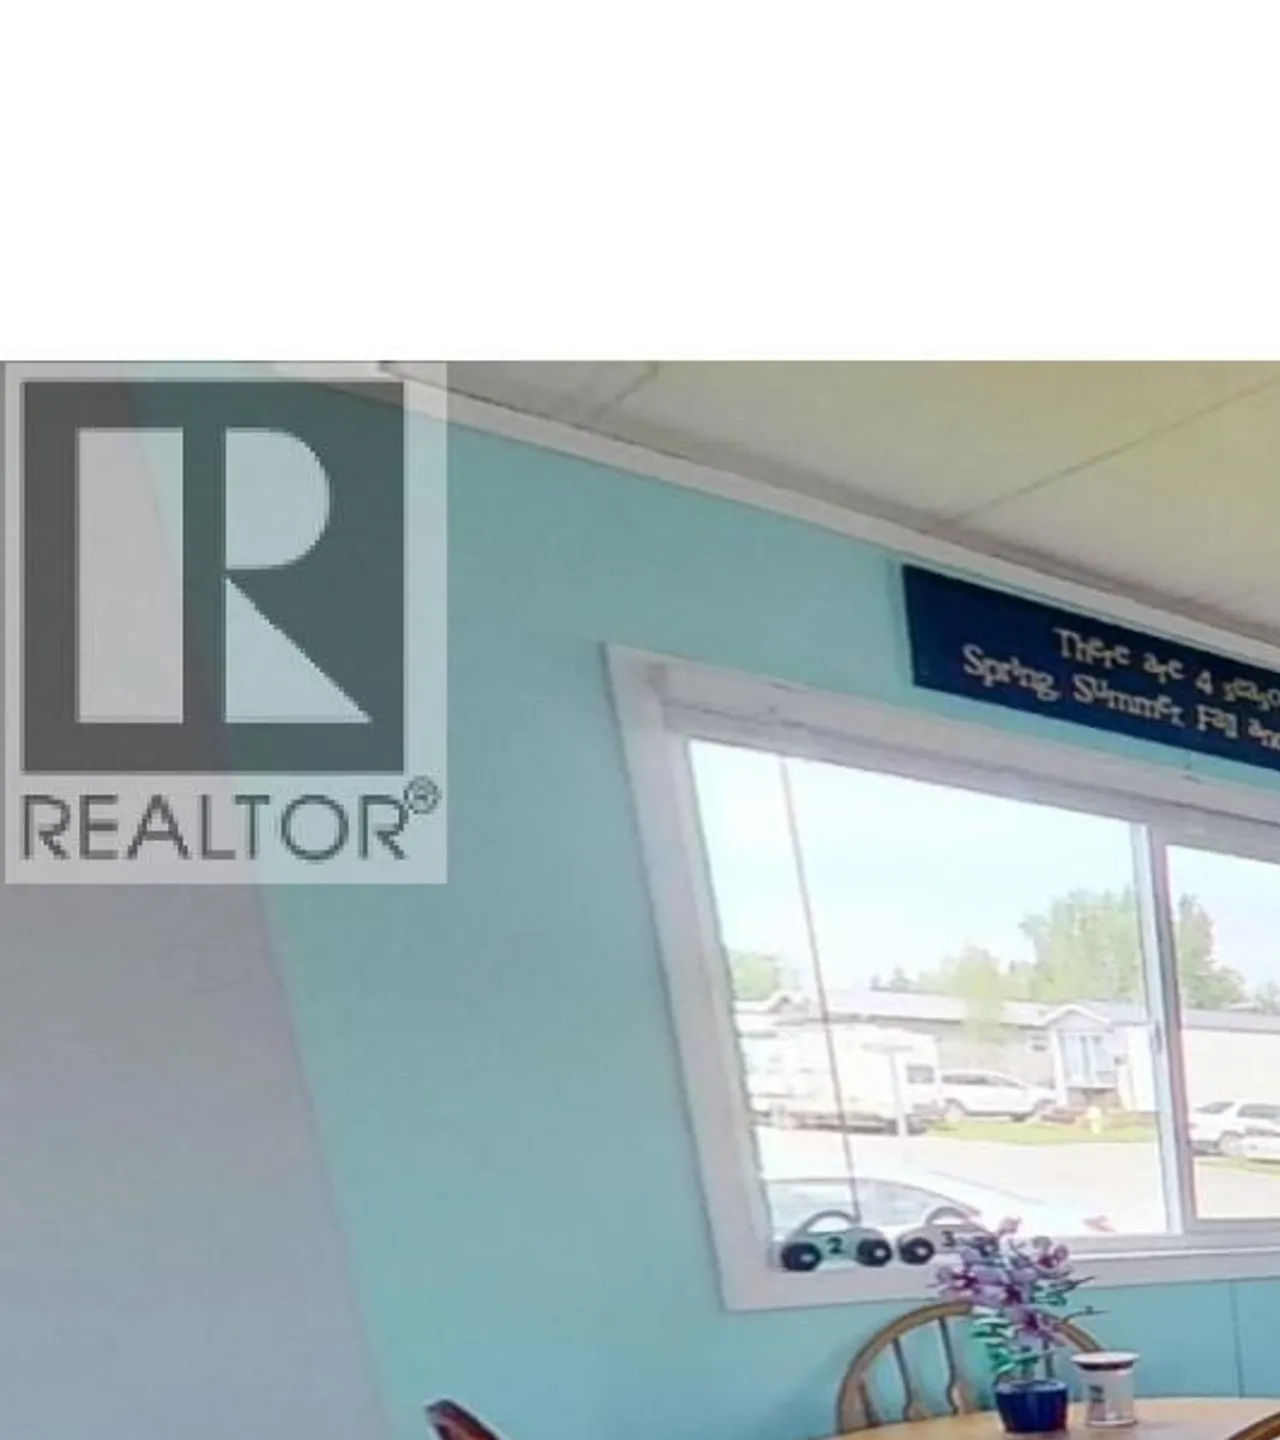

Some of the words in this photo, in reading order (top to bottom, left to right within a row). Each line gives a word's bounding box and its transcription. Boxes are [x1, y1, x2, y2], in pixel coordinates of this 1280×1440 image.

[1053, 626, 1131, 669] There
[1142, 652, 1186, 684] are
[1196, 669, 1215, 696] 4
[825, 1235, 844, 1255] 2
[941, 1230, 956, 1248] 3
